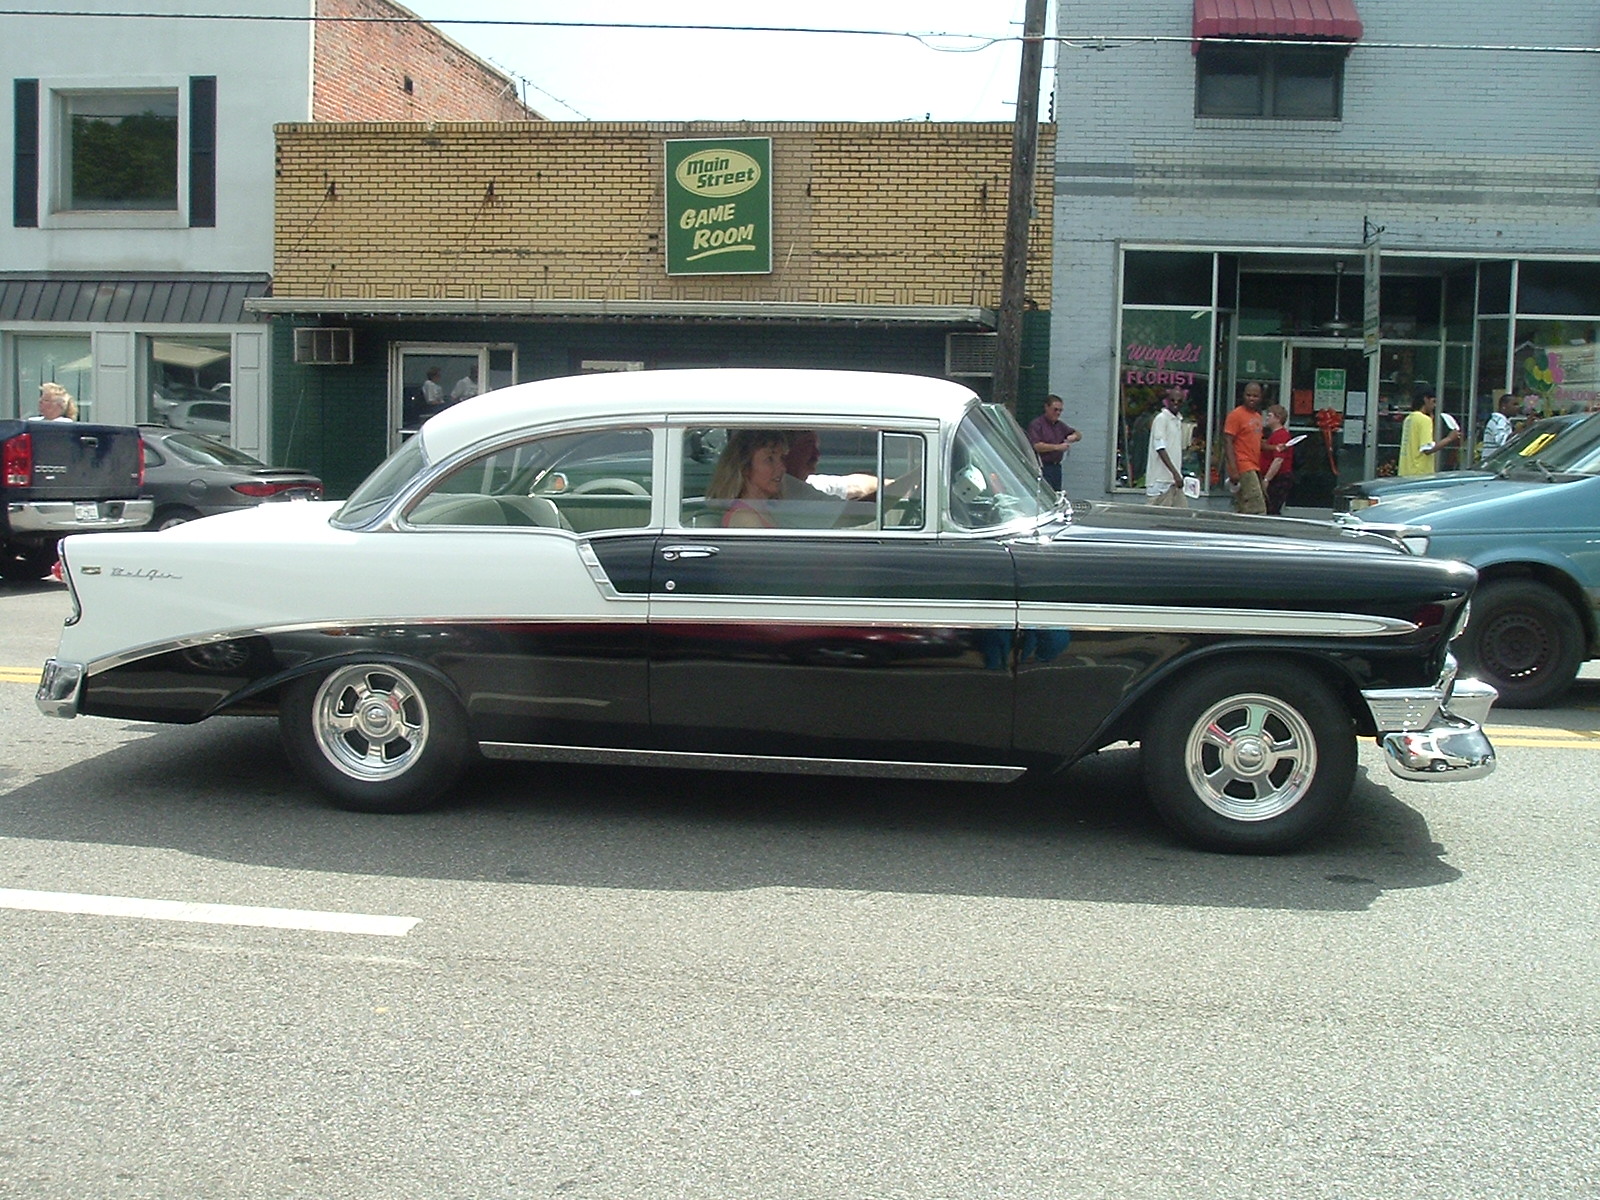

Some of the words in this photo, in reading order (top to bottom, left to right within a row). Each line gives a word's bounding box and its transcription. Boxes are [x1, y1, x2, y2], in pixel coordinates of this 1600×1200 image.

[687, 157, 730, 176] Main
[697, 167, 755, 188] Street
[680, 203, 736, 229] GAME
[693, 224, 754, 250] ROOM
[1126, 343, 1202, 369] Winfield
[1127, 371, 1196, 385] FLORIST
